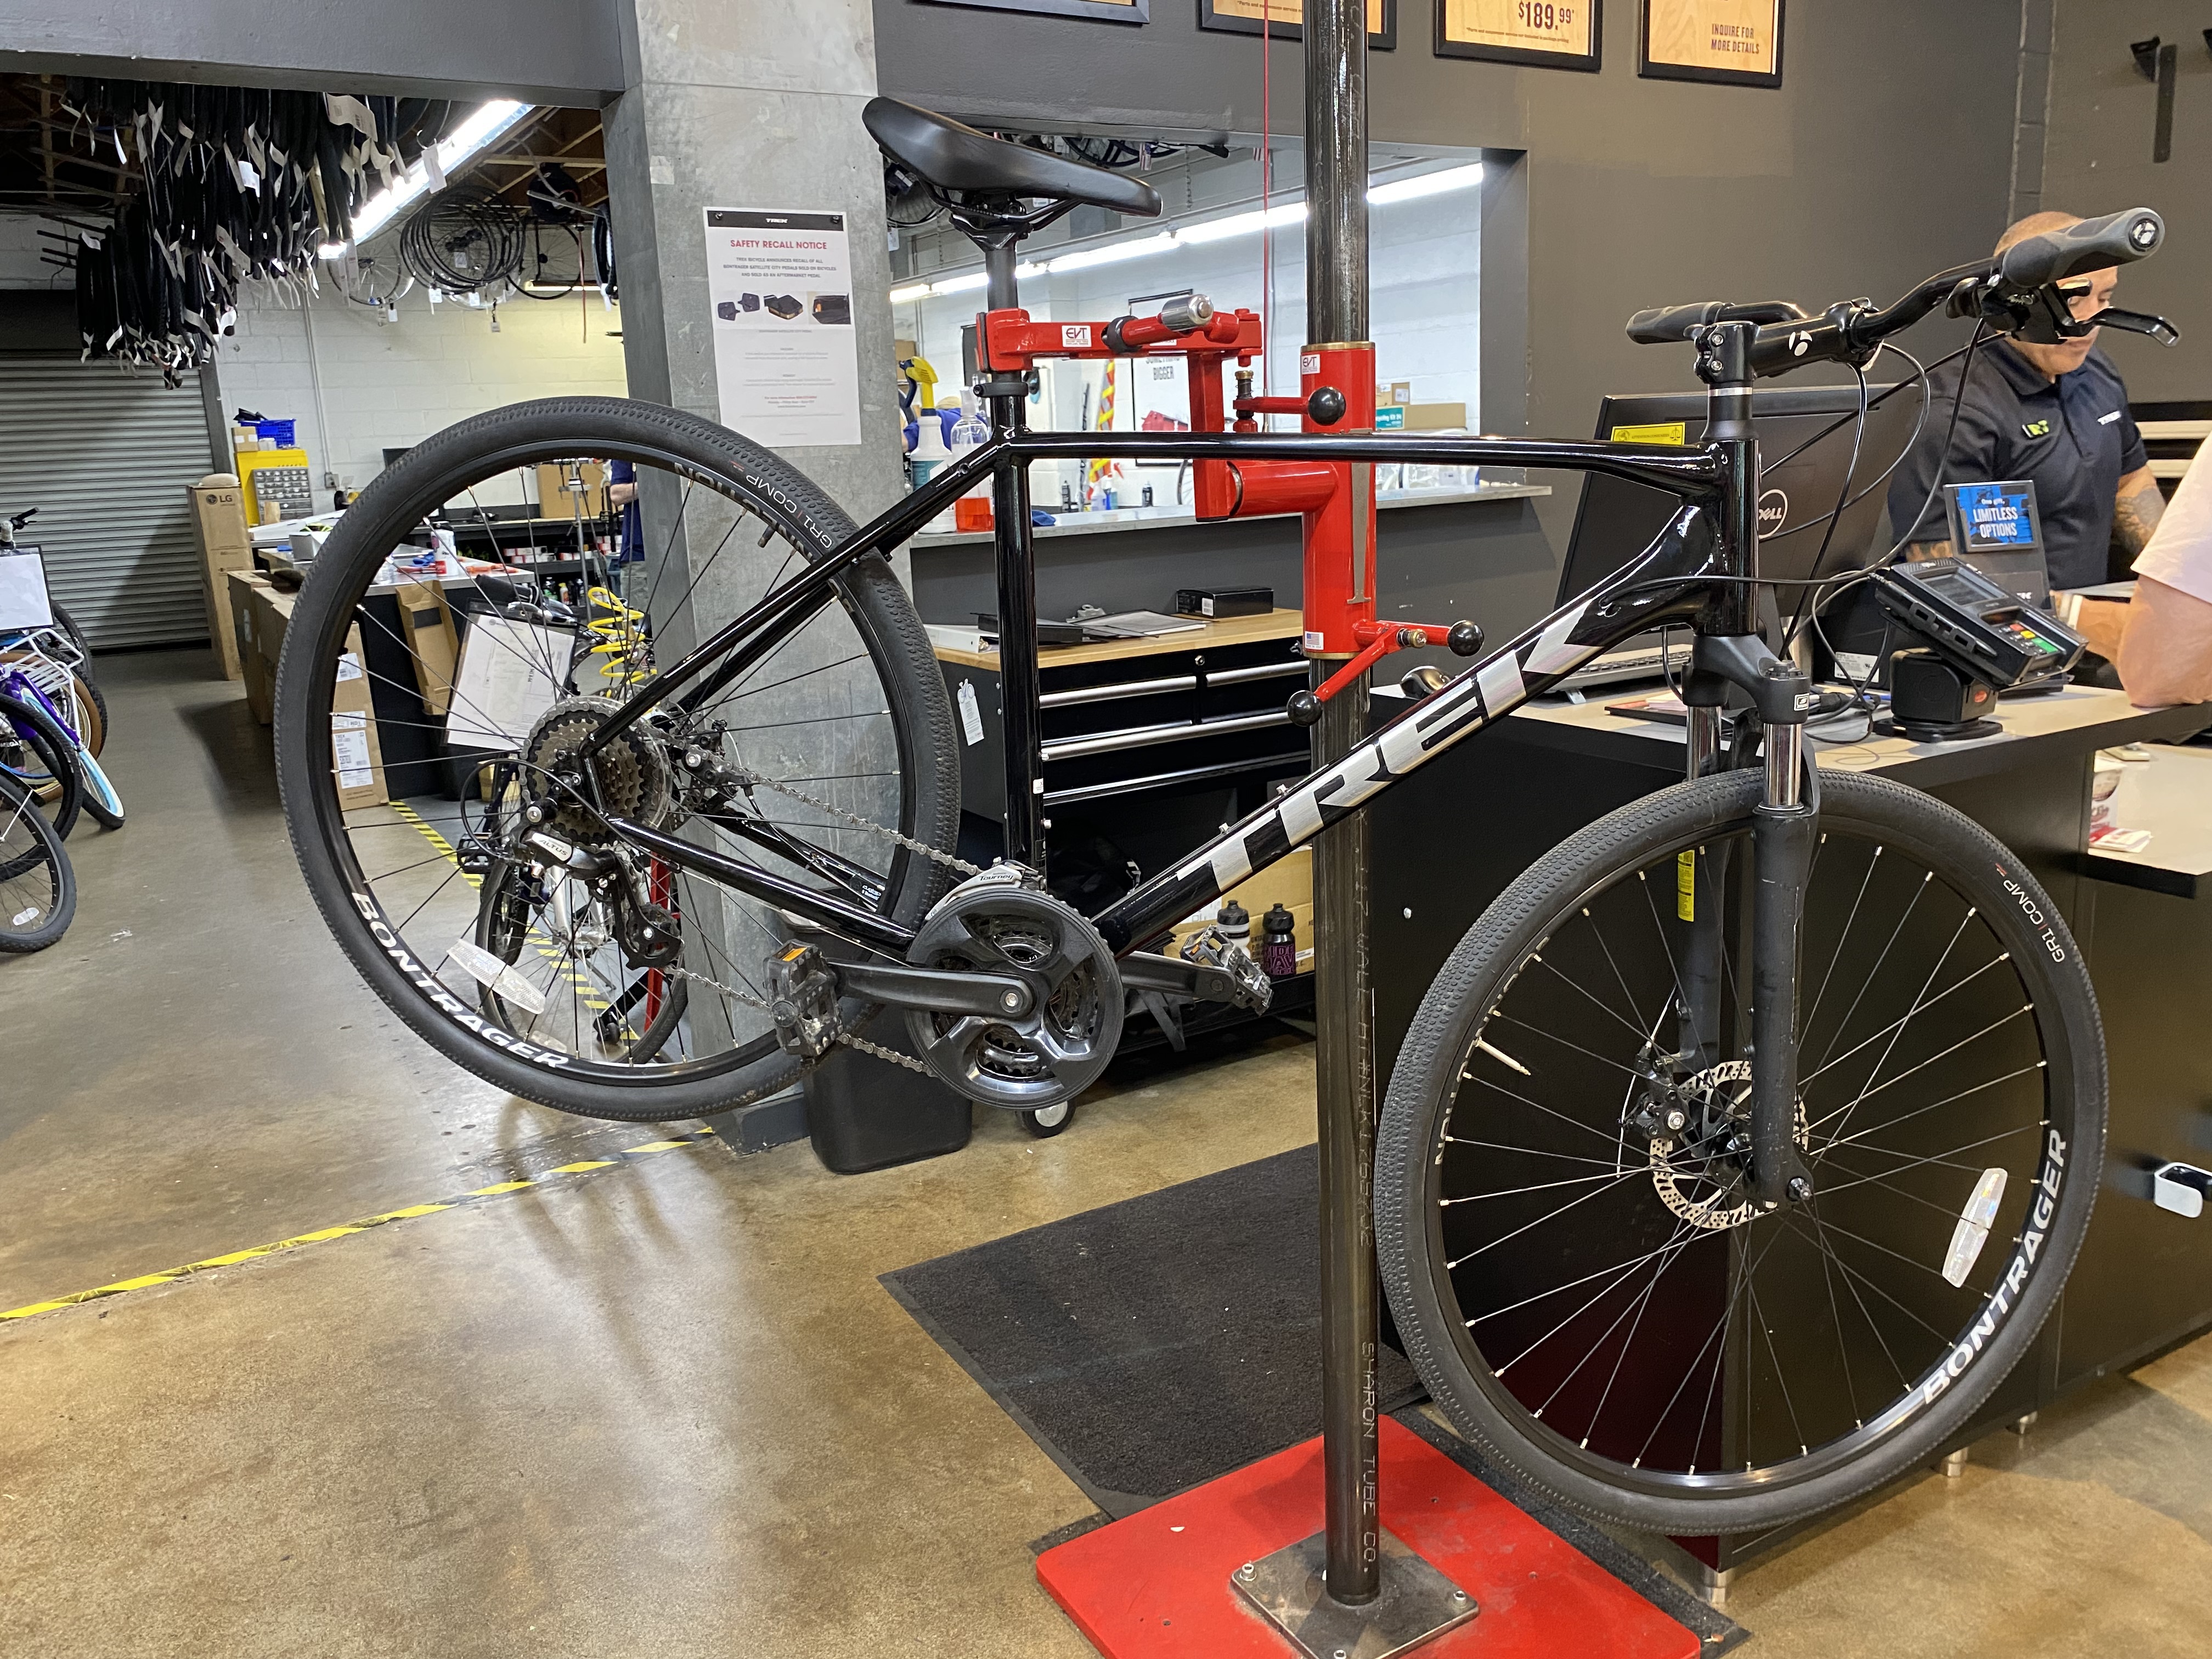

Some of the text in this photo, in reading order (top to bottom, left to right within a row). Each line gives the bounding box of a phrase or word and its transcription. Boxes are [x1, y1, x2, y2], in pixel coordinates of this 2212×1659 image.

[1712, 24, 1754, 39] INQUIRE FOR
[1711, 39, 1760, 54] MORE DETAILS
[730, 240, 760, 248] SAFETY
[1066, 328, 1087, 339] EVT
[1303, 357, 1317, 367] EVT
[1153, 366, 1174, 380] BIGGER
[746, 475, 797, 514] COMP
[1973, 506, 2018, 523] LIMITLESS
[803, 515, 832, 549] GR1
[1979, 522, 2017, 538] OPTIONS
[1177, 599, 1605, 892] TREK
[538, 840, 568, 856] ALTUS
[2004, 879, 2044, 925] COMP
[2042, 928, 2066, 963] GR1
[1265, 955, 1294, 968] HAV
[352, 893, 568, 1068] BONTRAGER
[1922, 1128, 2067, 1405] BONTRAGER
[1362, 1342, 1376, 1573] SHARON TUBE CO.
